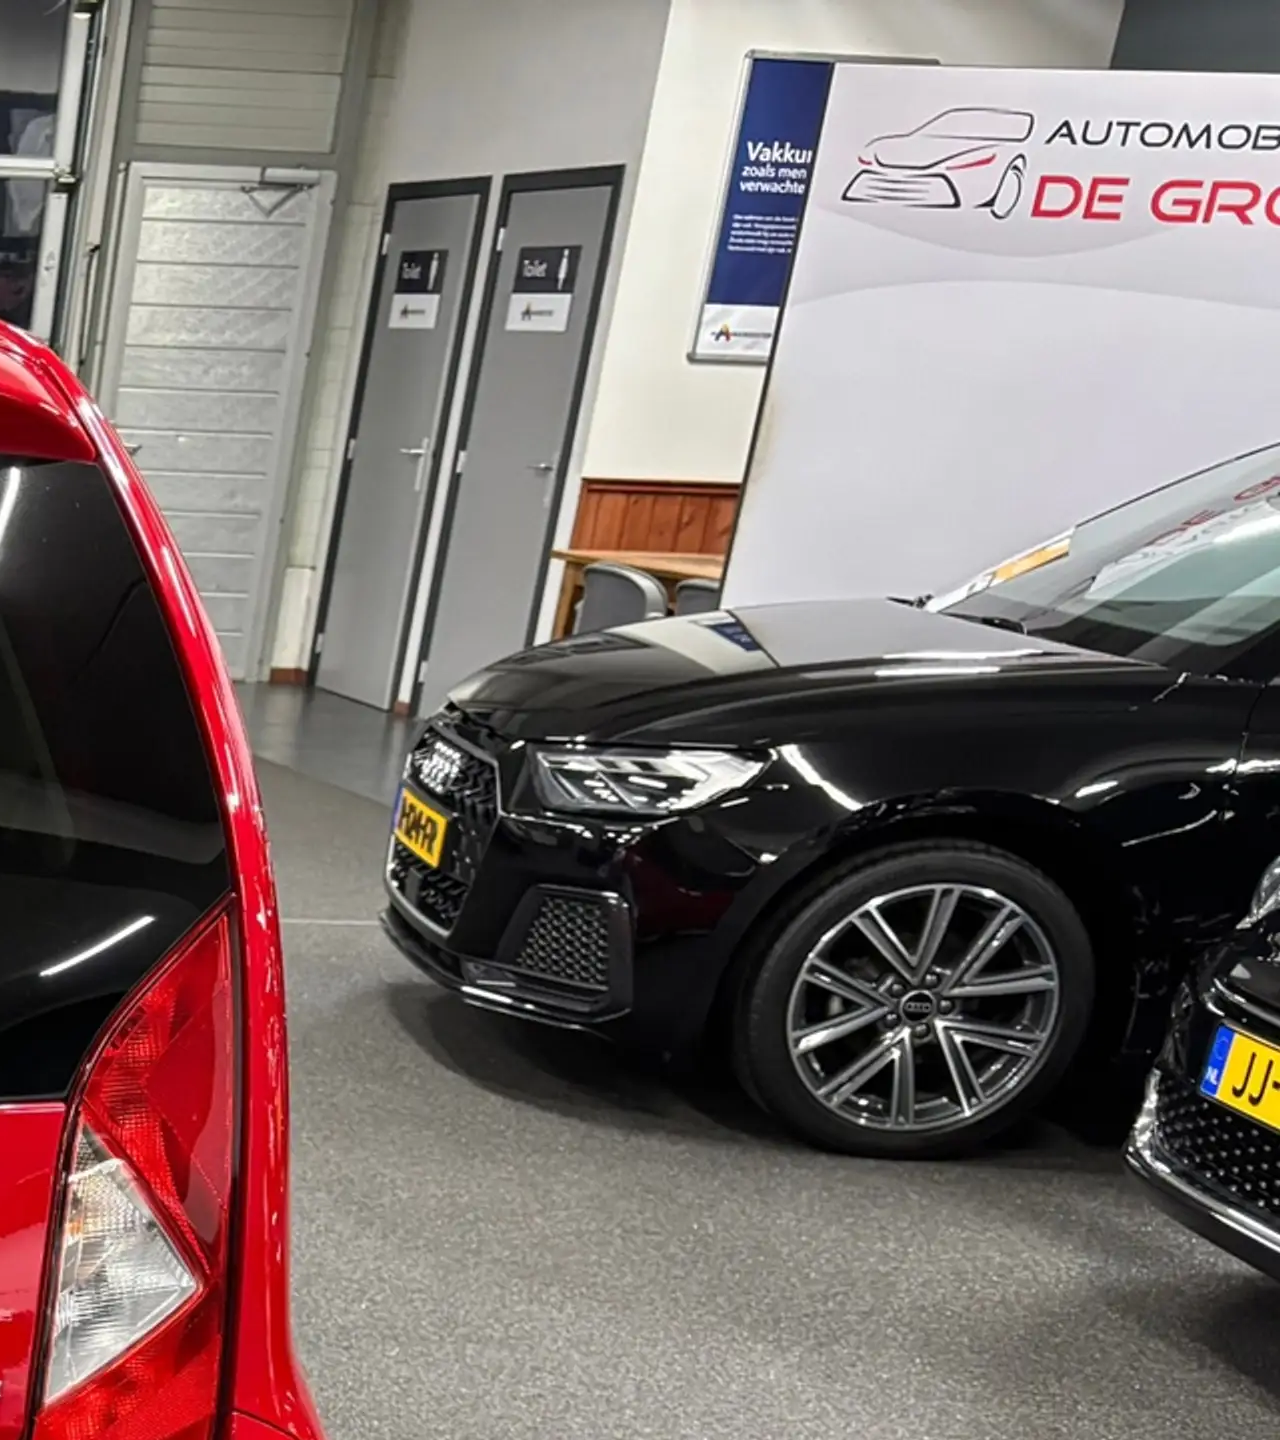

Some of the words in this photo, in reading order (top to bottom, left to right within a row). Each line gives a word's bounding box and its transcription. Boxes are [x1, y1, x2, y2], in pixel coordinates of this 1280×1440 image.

[1045, 119, 1280, 150] AUTOMOB
[741, 163, 776, 178] zoals
[1031, 175, 1130, 220] DE
